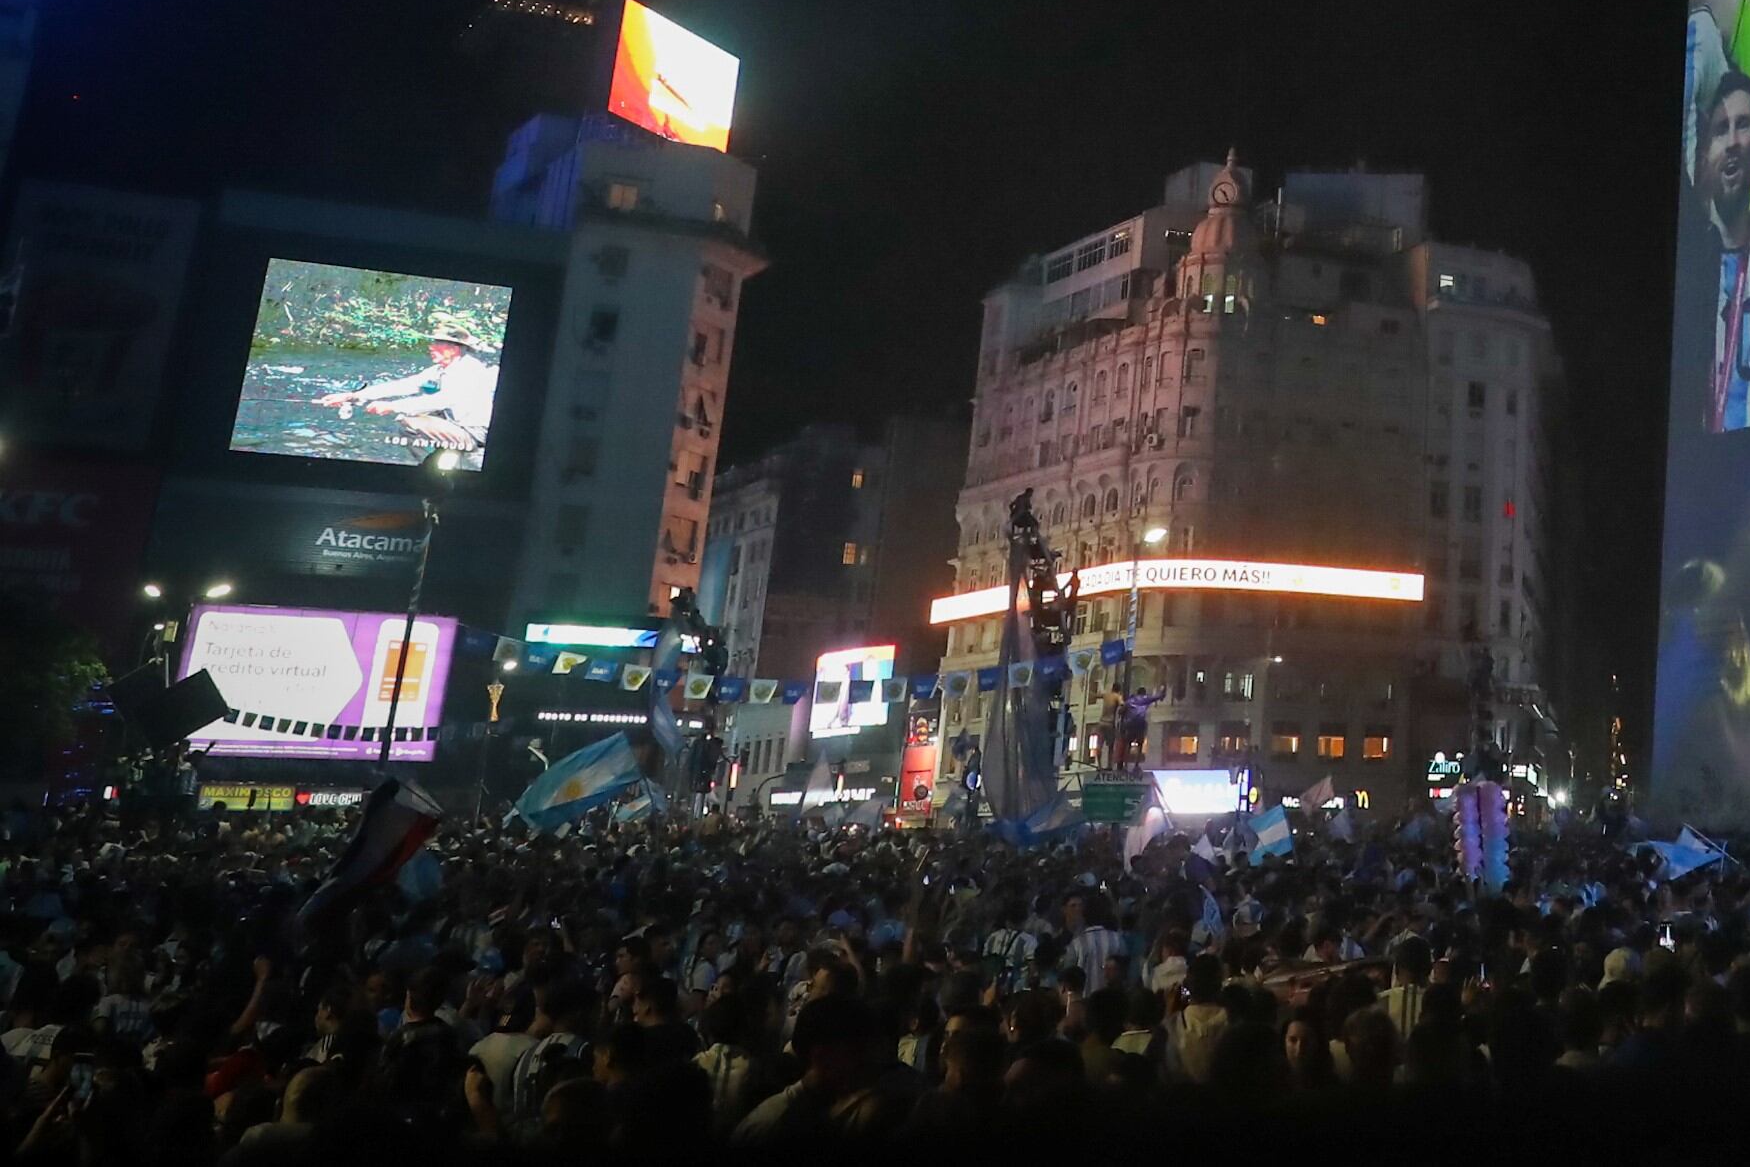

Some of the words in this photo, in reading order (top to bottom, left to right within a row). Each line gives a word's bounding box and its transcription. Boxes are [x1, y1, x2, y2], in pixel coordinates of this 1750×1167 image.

[315, 526, 425, 553] Atacama
[1146, 567, 1217, 583] QUIERO
[1222, 565, 1271, 584] MÁS!!
[205, 642, 264, 660] Tarjeta
[268, 645, 293, 660] de
[270, 664, 327, 679] virtual
